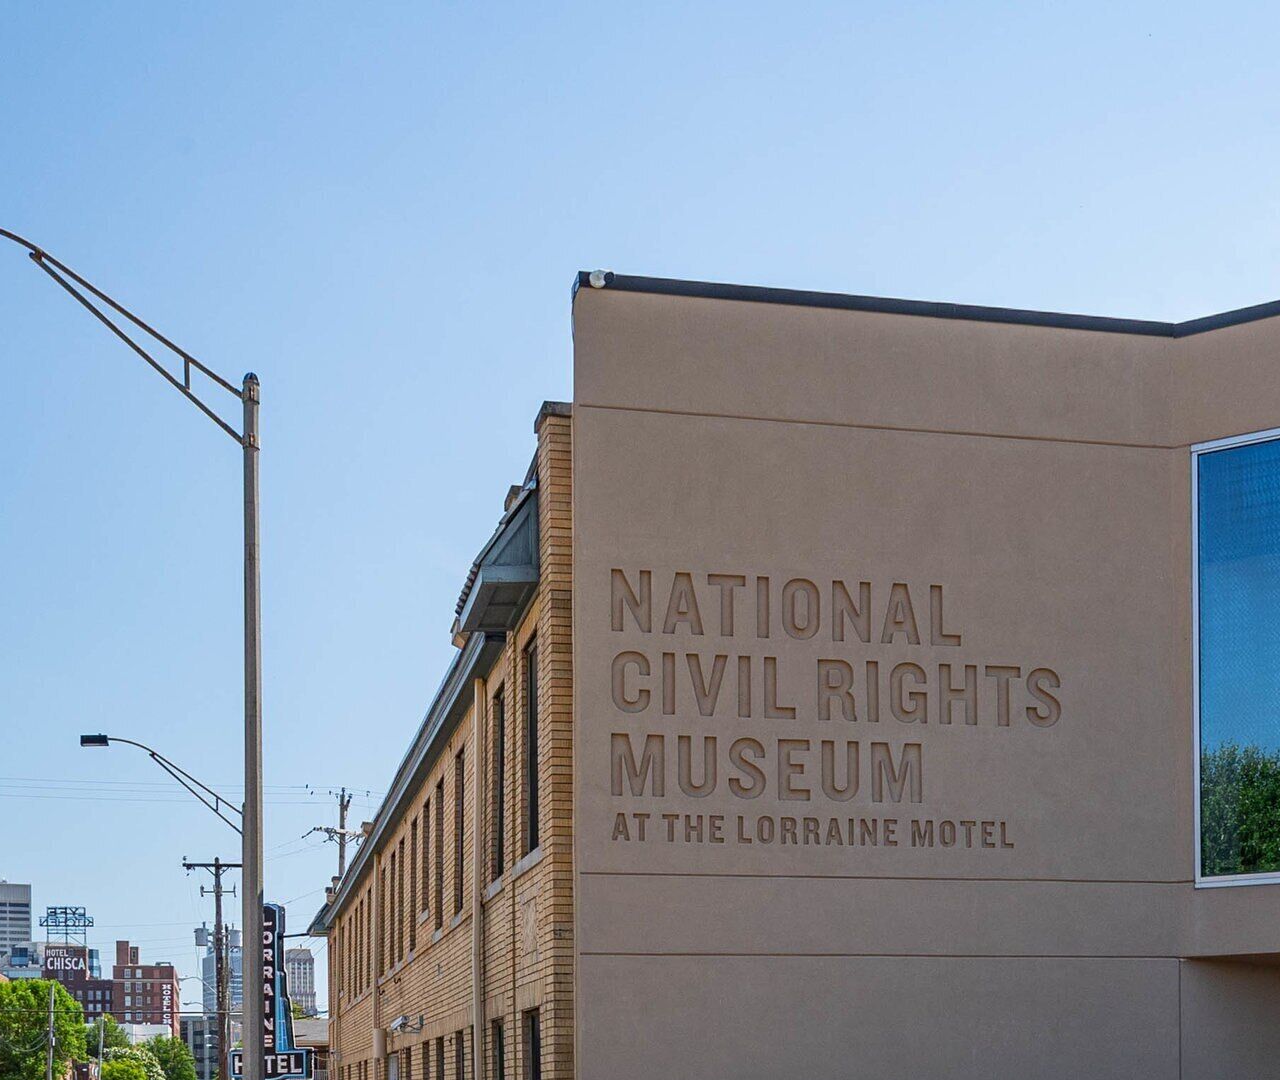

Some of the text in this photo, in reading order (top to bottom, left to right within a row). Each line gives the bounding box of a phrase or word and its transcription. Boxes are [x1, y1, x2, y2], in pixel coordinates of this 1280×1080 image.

[611, 569, 962, 646] NATIONAL
[612, 651, 1062, 728] CIVIL RIGHTS
[611, 733, 922, 803] MUSEUM
[612, 813, 1015, 849] AT THE LORRAINE MOTEL
[46, 949, 68, 957] HOTEL
[47, 958, 85, 970] CHISCA
[234, 1055, 302, 1074] HTEL
